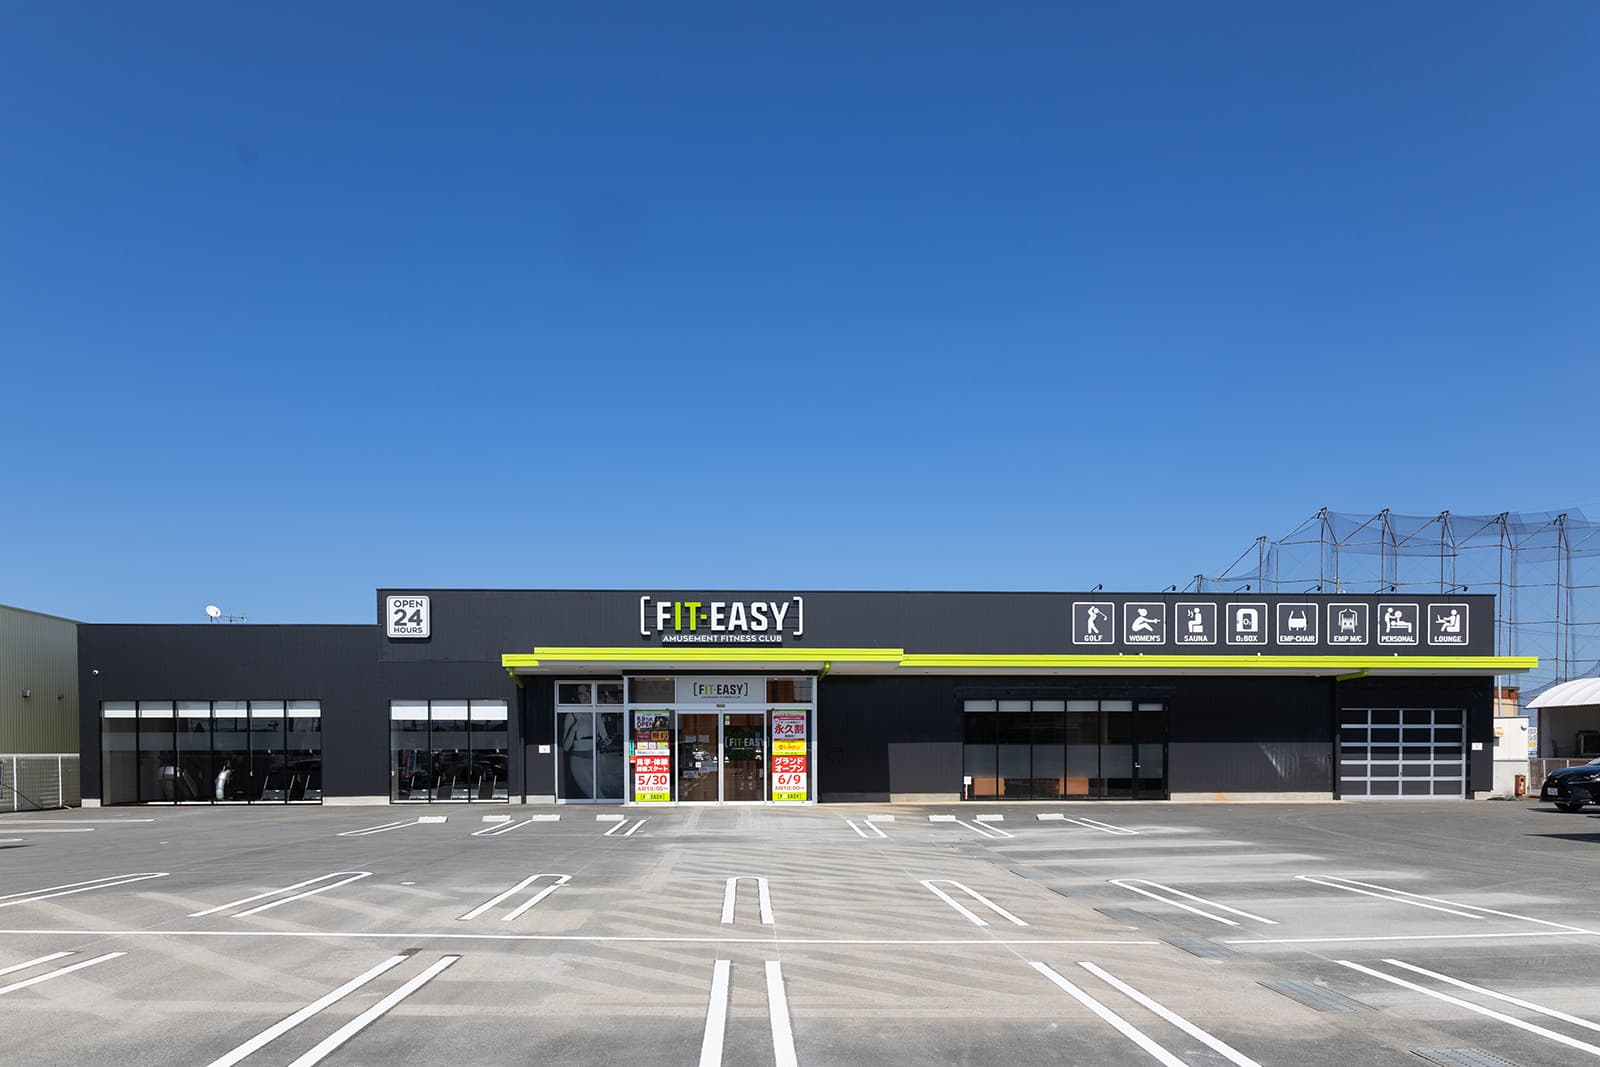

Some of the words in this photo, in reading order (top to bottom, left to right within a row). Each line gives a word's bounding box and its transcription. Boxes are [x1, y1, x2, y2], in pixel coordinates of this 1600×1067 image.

[393, 600, 423, 608] OPEN
[393, 609, 423, 626] 24
[774, 723, 805, 735] 永久割
[775, 757, 804, 765] グランド
[775, 765, 804, 773] オープン
[638, 775, 667, 785] 5/30
[778, 774, 801, 785] 6/9
